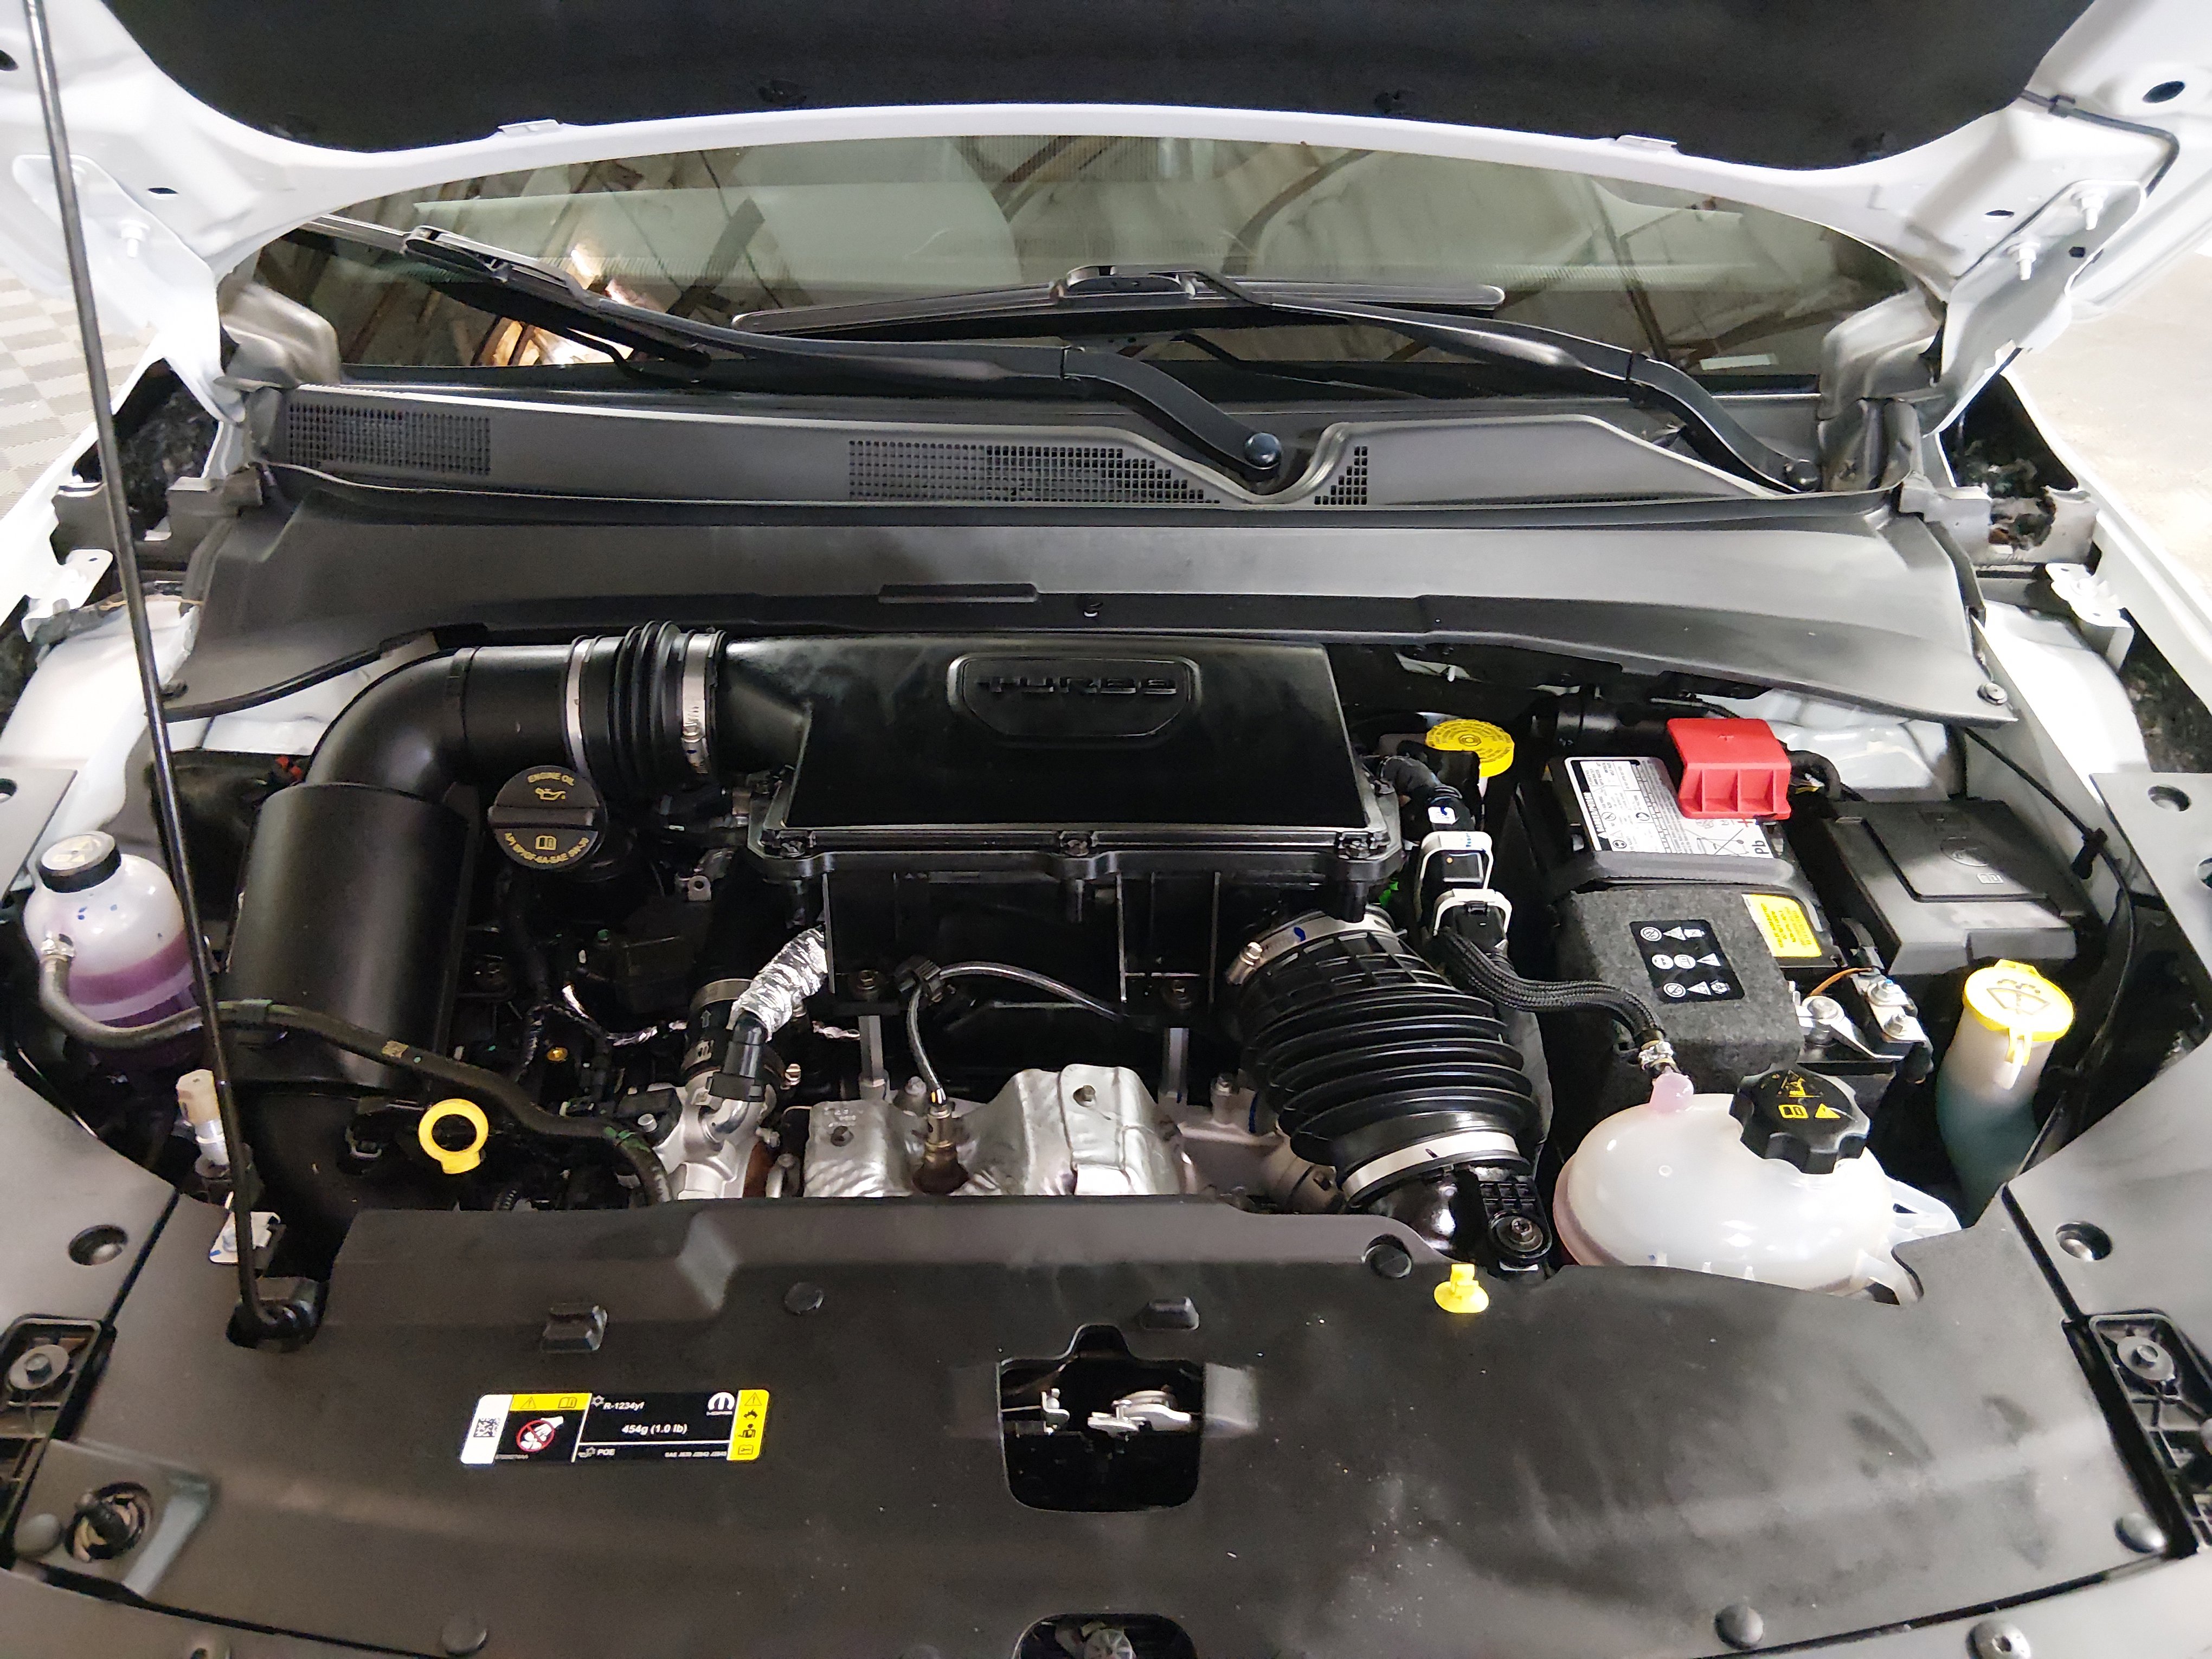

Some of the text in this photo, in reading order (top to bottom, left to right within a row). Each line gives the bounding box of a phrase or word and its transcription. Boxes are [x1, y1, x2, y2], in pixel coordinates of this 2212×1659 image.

[528, 772, 575, 786] ENGINE OIL
[504, 833, 517, 846] API
[1752, 840, 1770, 854] Pb
[603, 1401, 645, 1411] R-1234yf
[621, 1423, 688, 1436] 454g (1.0 lb)
